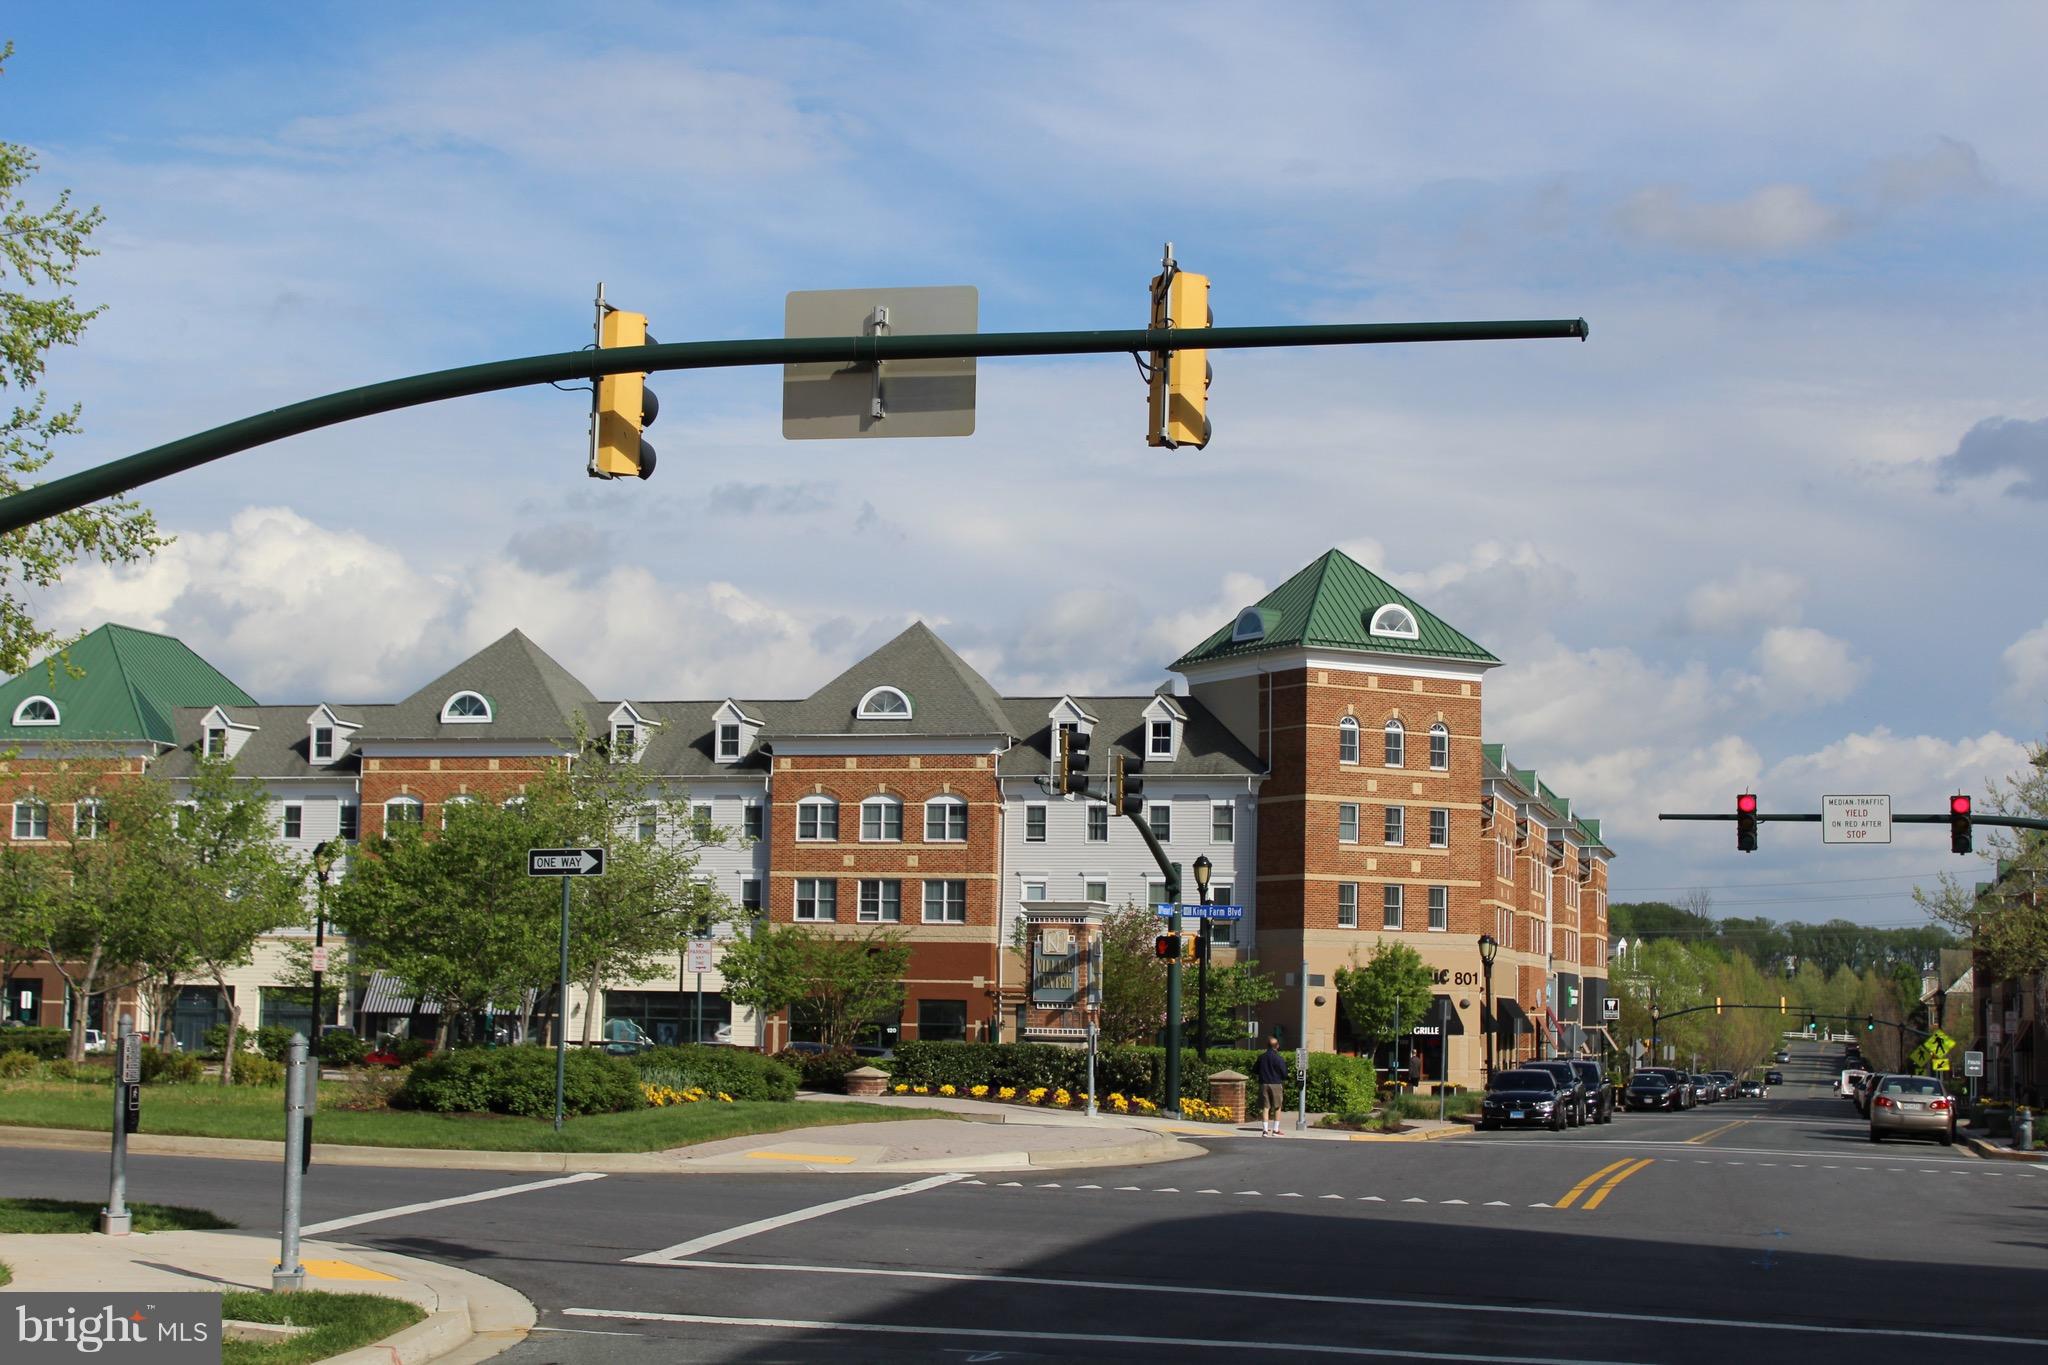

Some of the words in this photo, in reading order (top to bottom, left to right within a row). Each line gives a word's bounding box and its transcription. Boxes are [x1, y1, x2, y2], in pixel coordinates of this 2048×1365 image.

[1845, 809, 1869, 817] YIELD
[1831, 820, 1841, 828] ON
[1845, 820, 1858, 828] RED
[1861, 820, 1882, 828] AFTER
[1846, 830, 1867, 839] STOP
[536, 857, 557, 868] ONE
[560, 857, 582, 868] WAY
[1192, 906, 1207, 917] King
[1209, 906, 1225, 916] Farm
[1227, 907, 1242, 917] Blvd
[1454, 971, 1478, 985] 801
[1413, 1026, 1440, 1035] GRILLE
